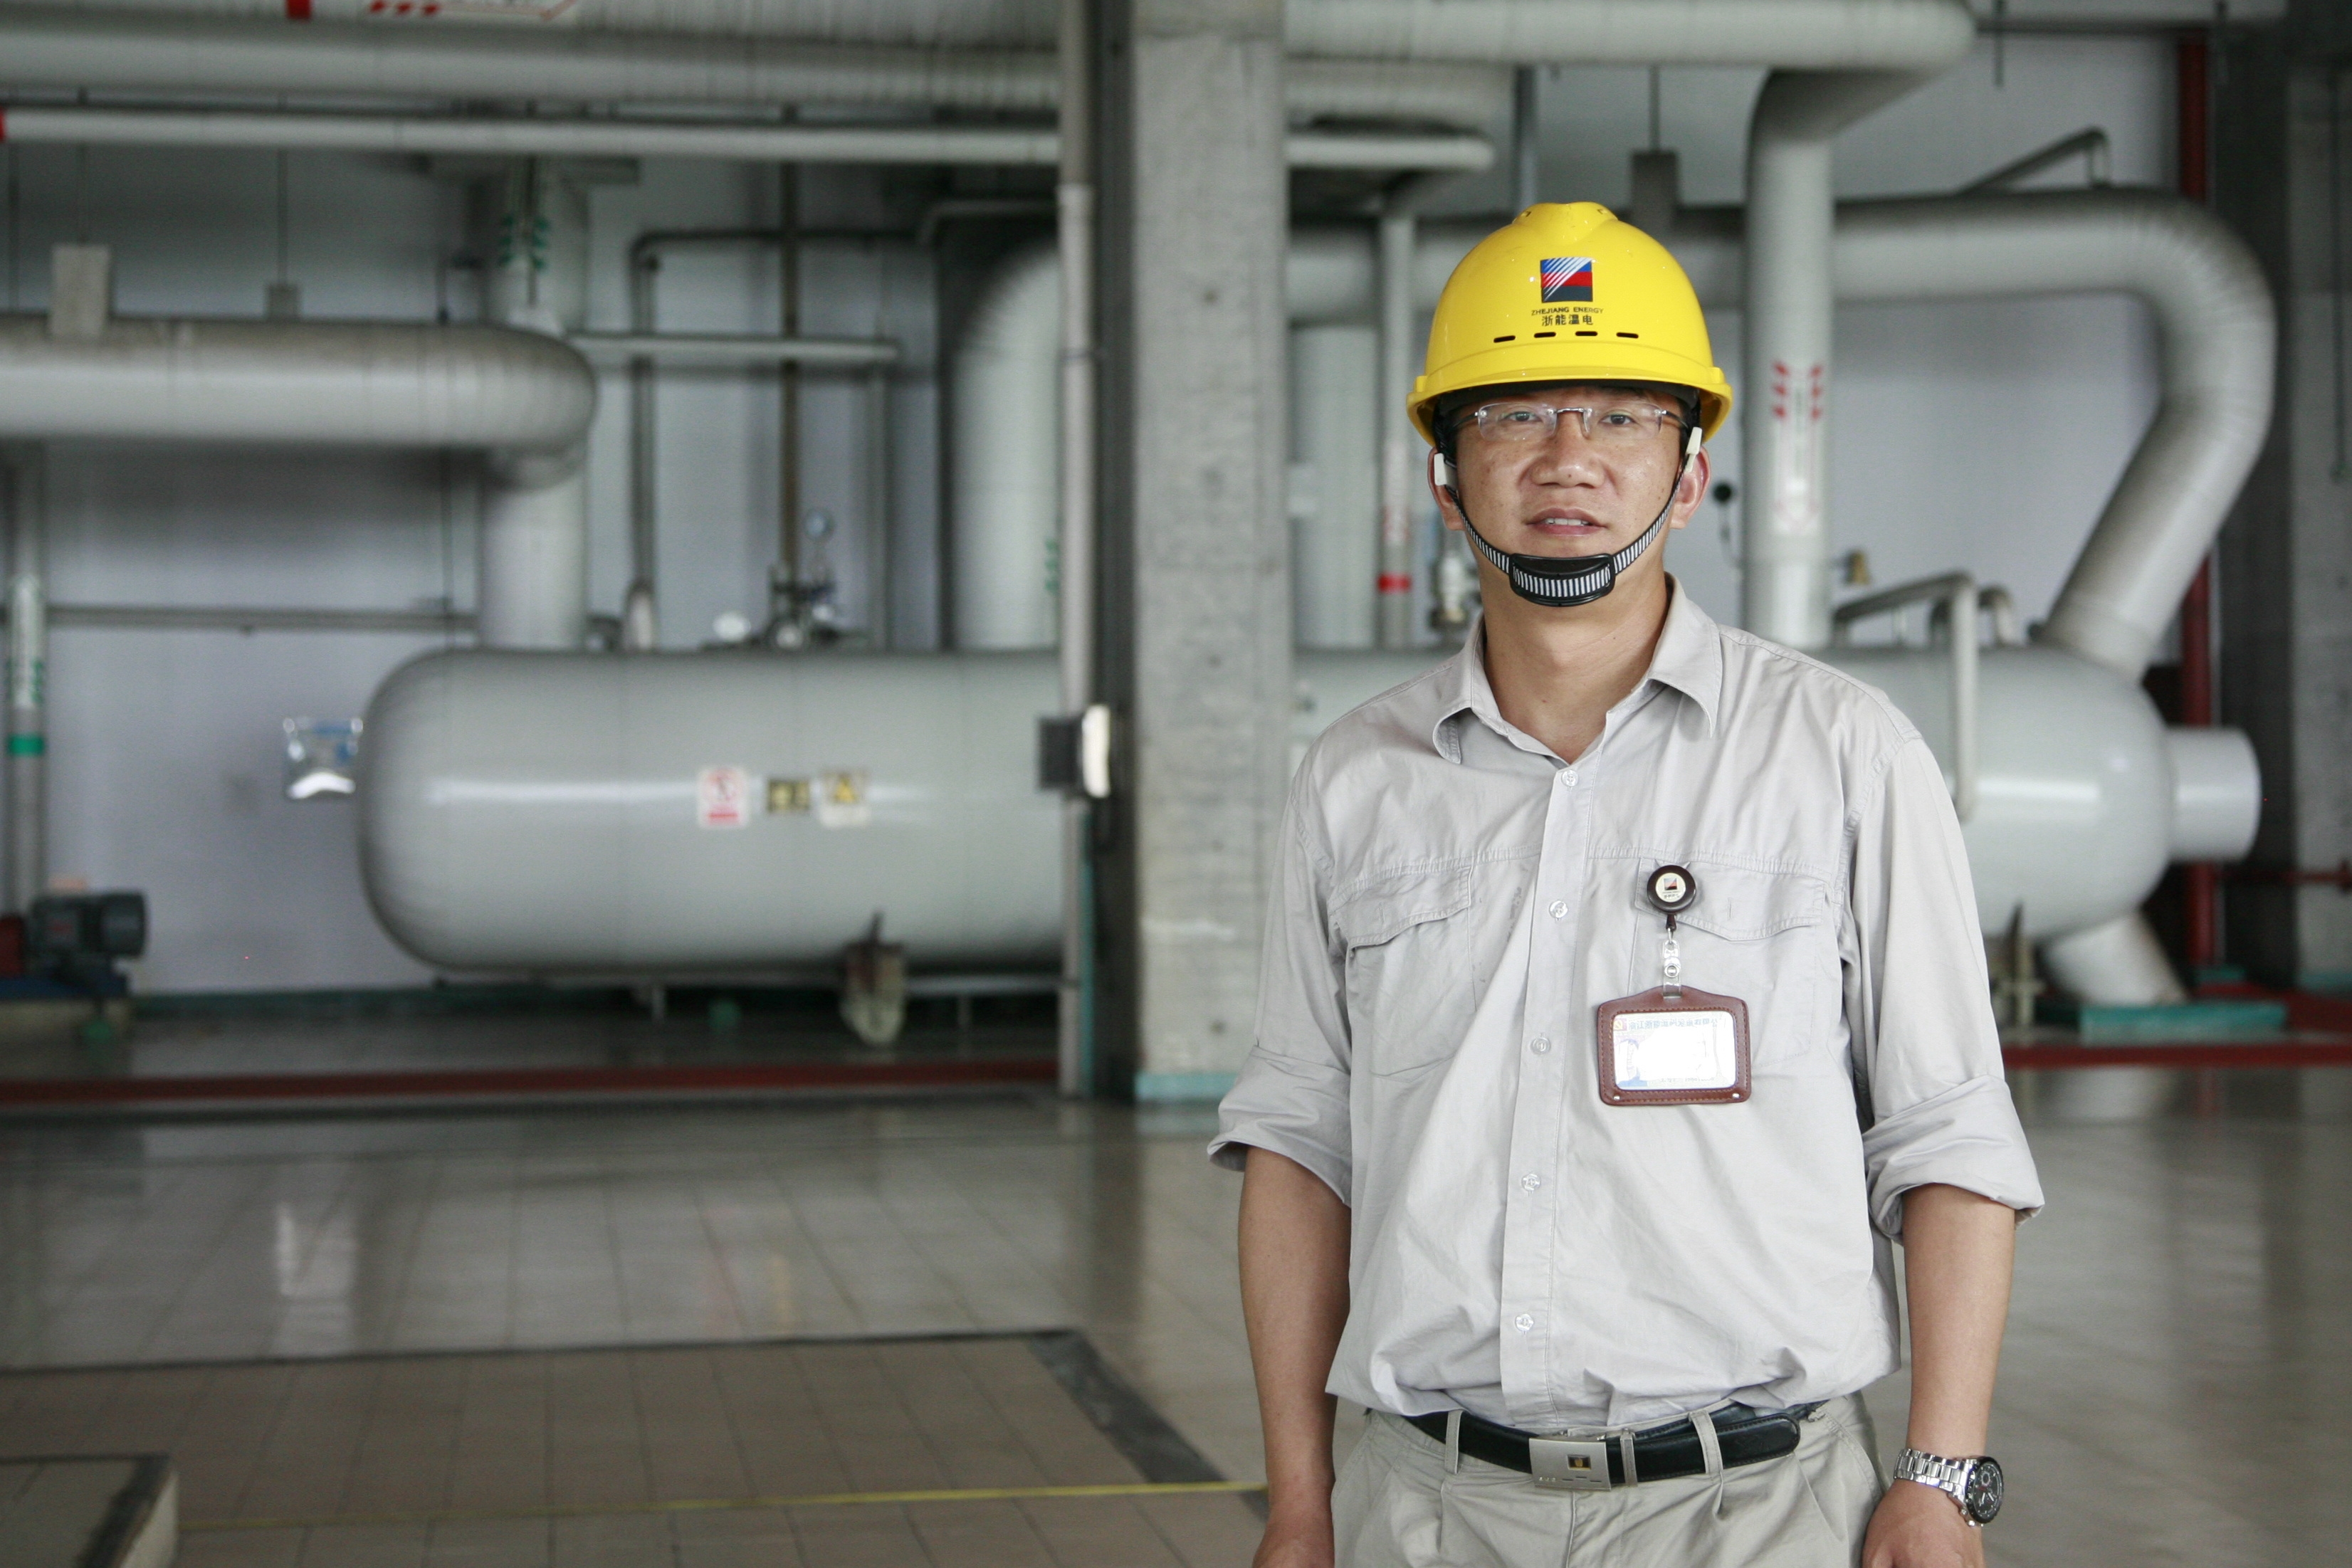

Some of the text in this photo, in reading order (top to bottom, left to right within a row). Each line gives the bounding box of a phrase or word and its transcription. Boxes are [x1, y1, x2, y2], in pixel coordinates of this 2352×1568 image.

[1531, 307, 1570, 316] ZHEJIANG
[1542, 314, 1593, 326] 浙能温电
